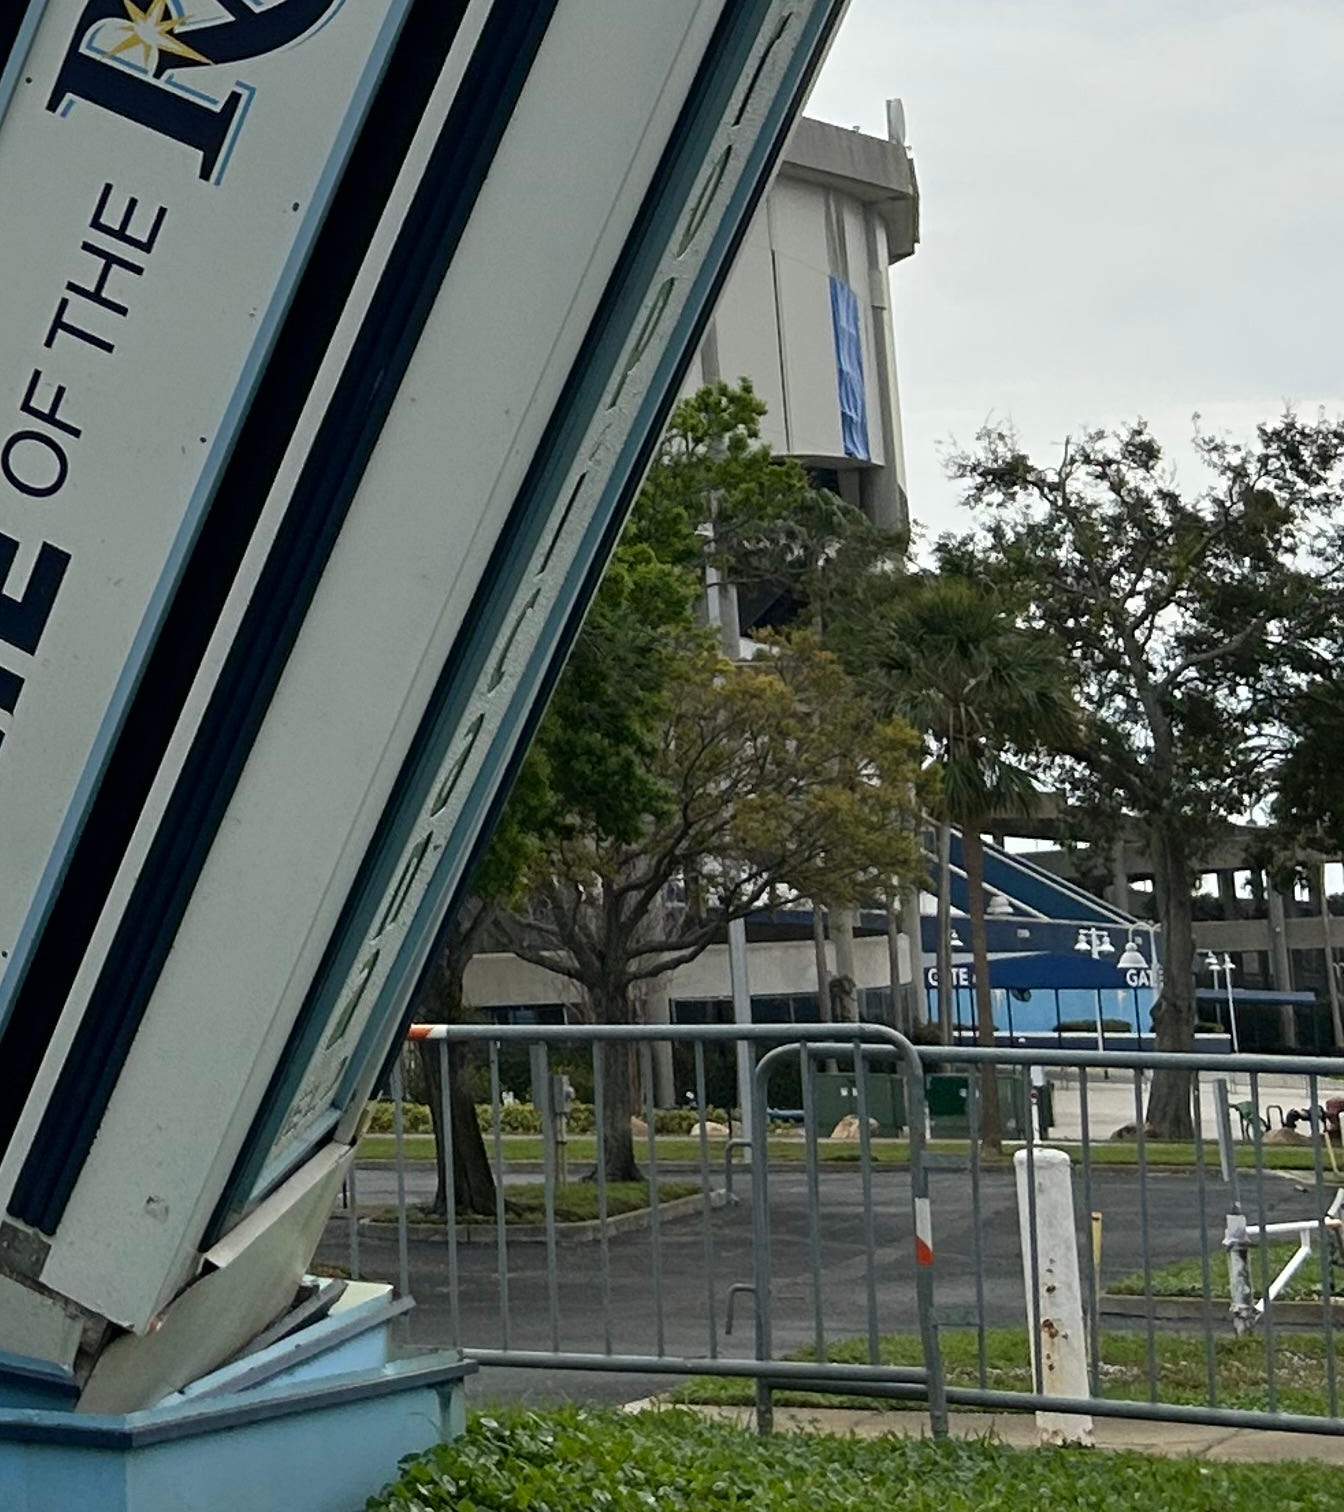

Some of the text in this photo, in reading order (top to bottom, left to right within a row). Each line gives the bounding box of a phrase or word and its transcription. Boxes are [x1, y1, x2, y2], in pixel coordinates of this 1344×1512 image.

[0, 368, 83, 499] OF
[44, 182, 168, 353] THE
[928, 968, 968, 986] GTE
